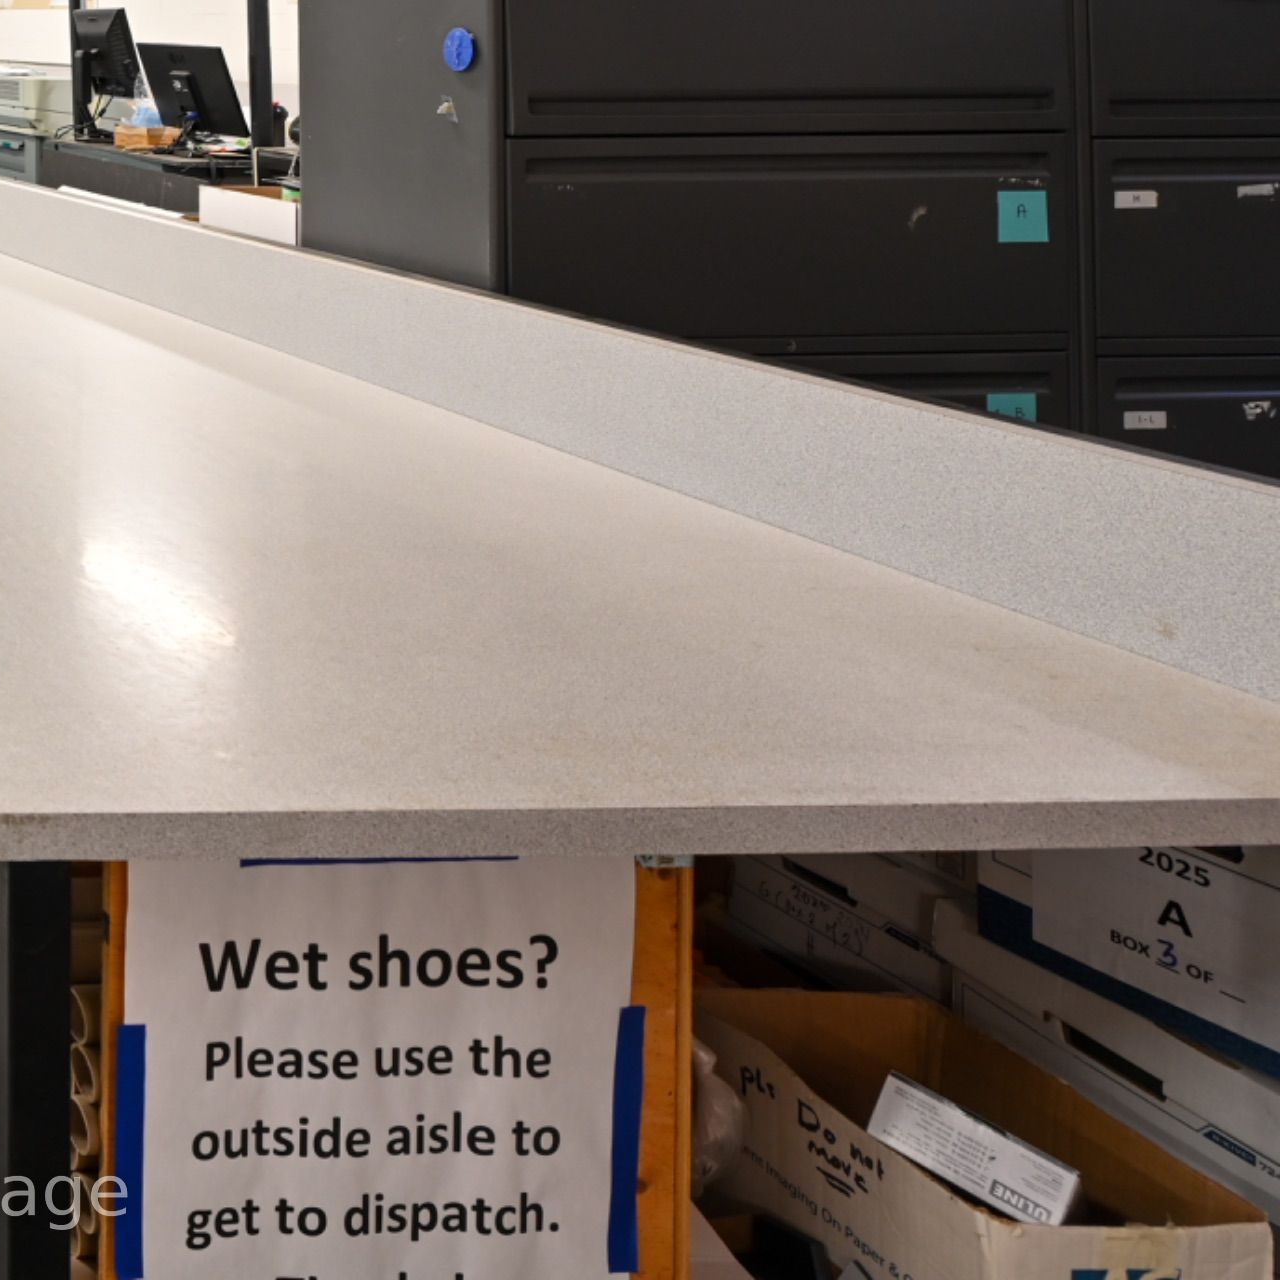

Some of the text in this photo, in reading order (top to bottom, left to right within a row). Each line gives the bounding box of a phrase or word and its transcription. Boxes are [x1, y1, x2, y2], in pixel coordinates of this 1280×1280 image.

[1016, 204, 1028, 218] A
[1138, 846, 1211, 888] 2025
[1157, 900, 1193, 938] A
[198, 933, 559, 992] Wet shoes?
[1109, 928, 1214, 984] BOX 3 OF
[205, 1034, 552, 1081] Please use the
[191, 1110, 561, 1161] outside aisle to
[849, 1142, 884, 1181] not
[185, 1192, 560, 1251] get to dispatch.
[765, 1161, 819, 1217] Imaging
[821, 1207, 842, 1233] On
[844, 1225, 886, 1267] Paper
[993, 1181, 1049, 1221] ULINE
